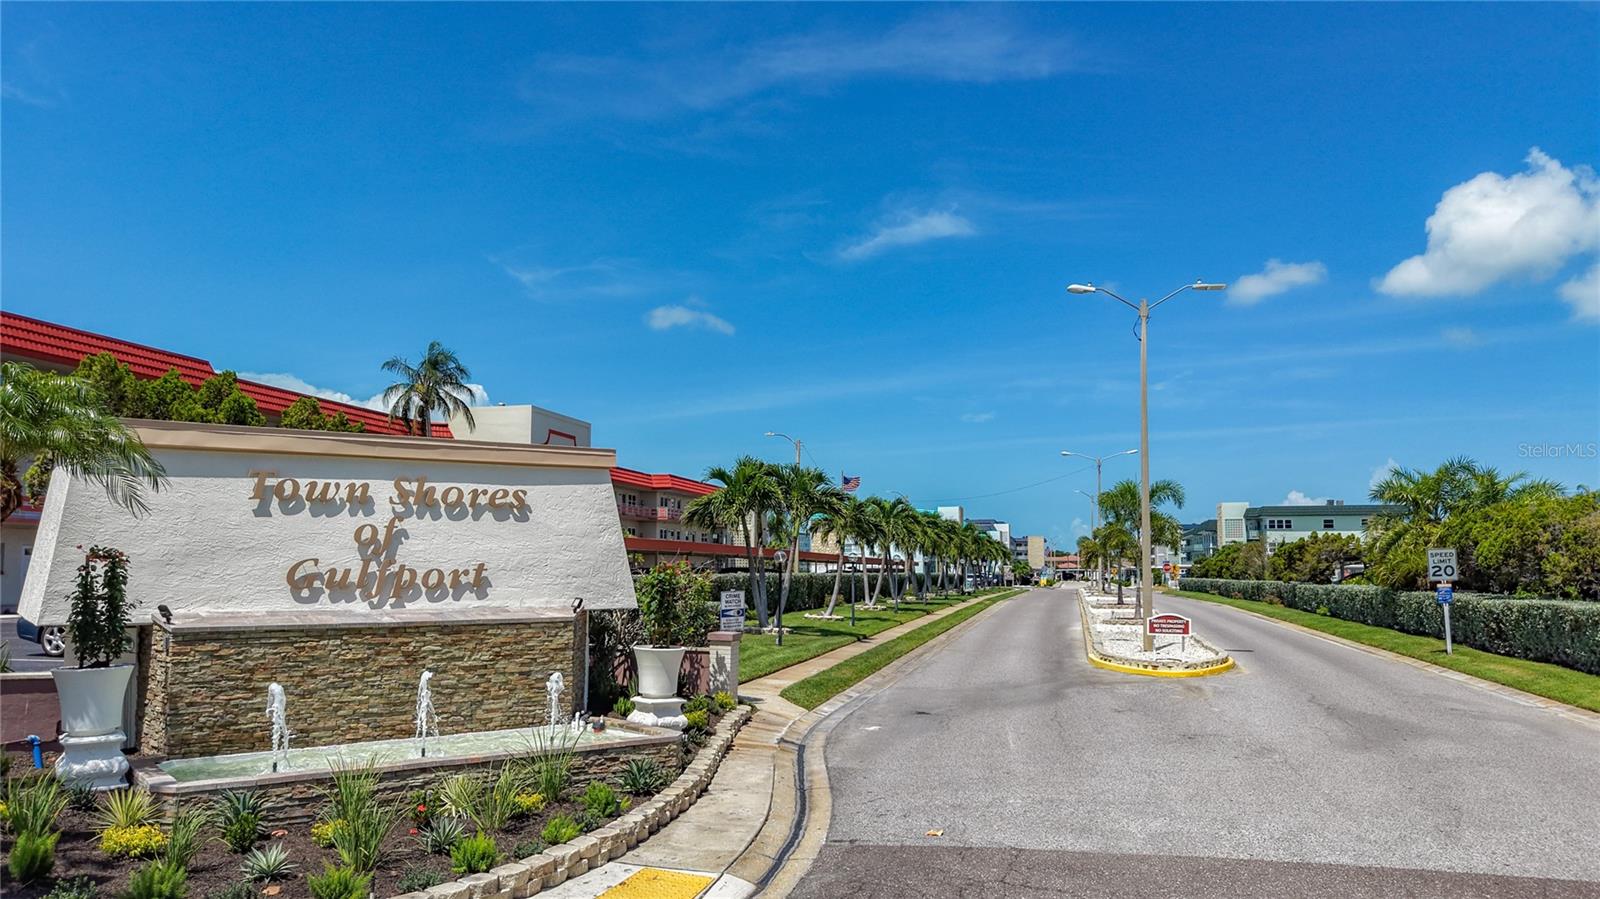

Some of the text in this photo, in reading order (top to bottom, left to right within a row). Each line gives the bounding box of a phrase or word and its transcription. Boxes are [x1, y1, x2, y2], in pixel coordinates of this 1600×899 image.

[248, 468, 528, 509] Town Shores
[353, 516, 405, 558] of
[286, 557, 489, 600] Gulfport
[1431, 564, 1455, 577] 20
